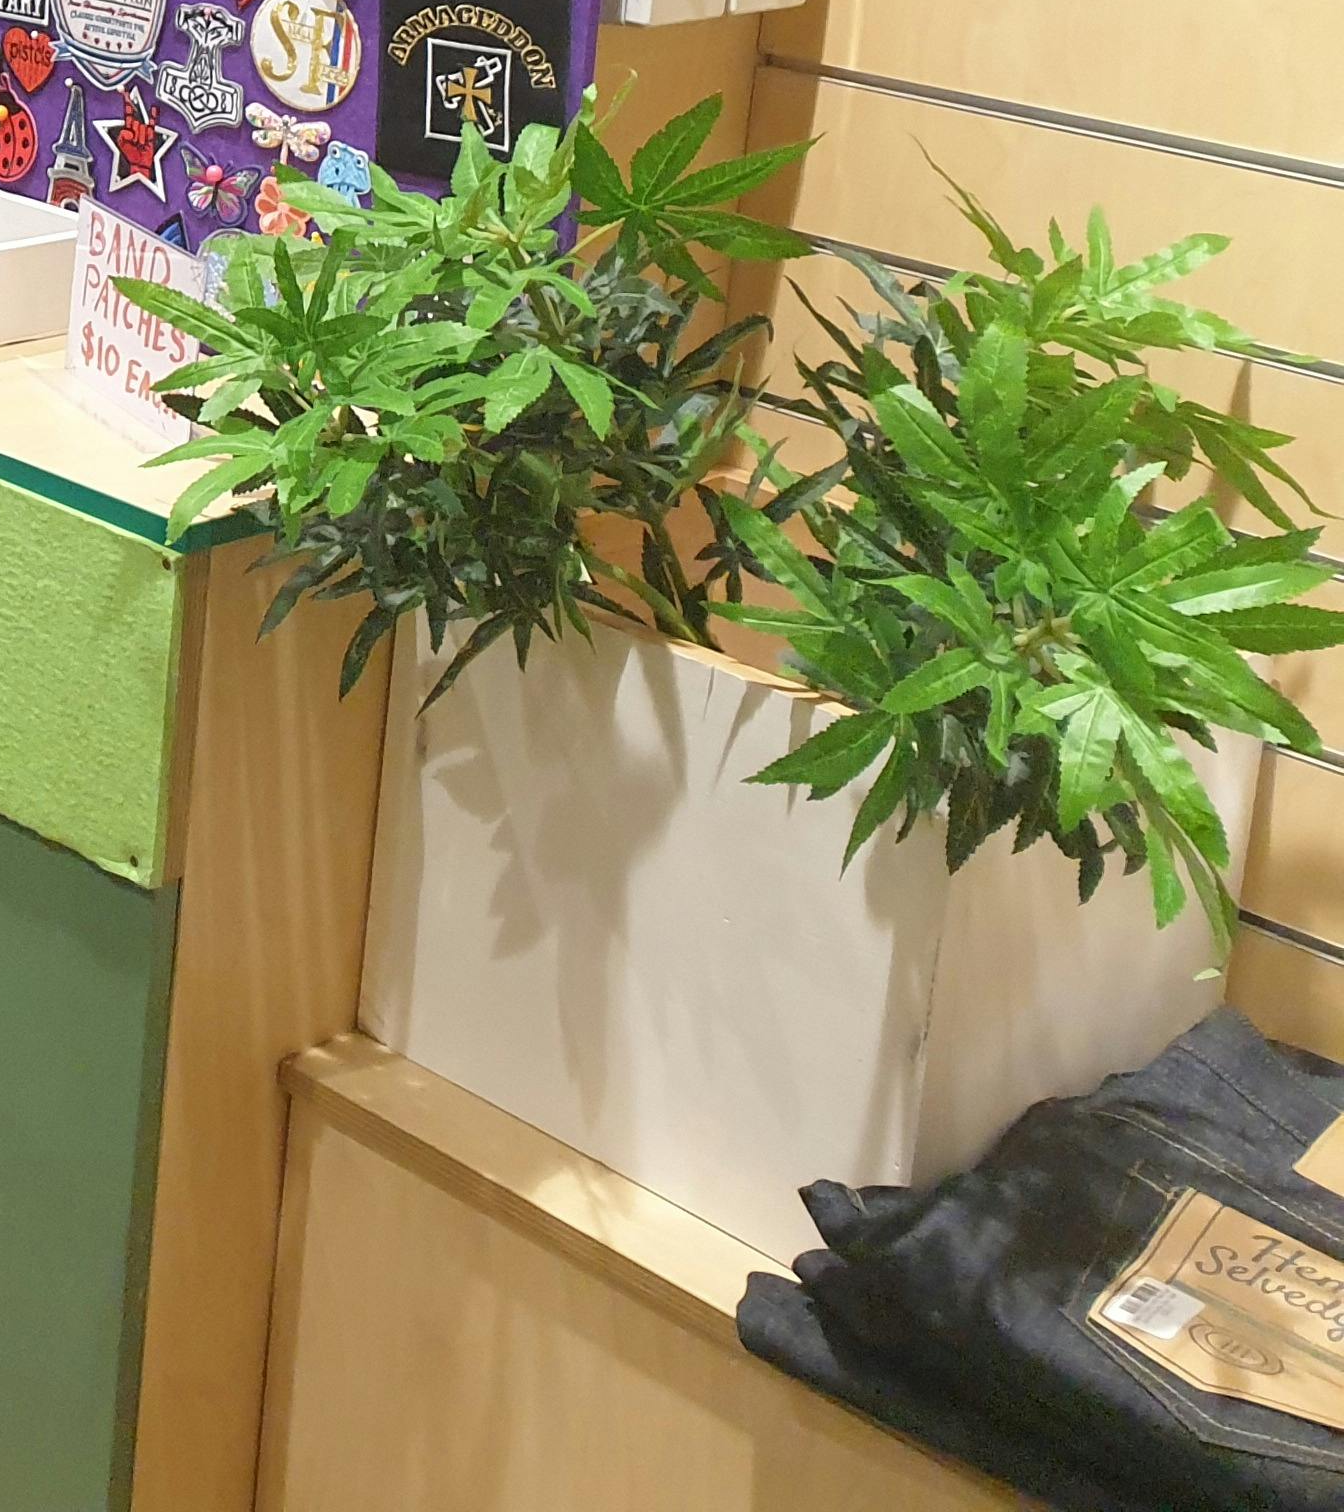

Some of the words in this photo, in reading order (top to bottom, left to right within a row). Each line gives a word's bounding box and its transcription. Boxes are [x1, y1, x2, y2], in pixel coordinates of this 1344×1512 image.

[387, 4, 557, 90] ARMAGEDDON
[88, 210, 172, 286] BAND
[81, 320, 121, 378] $10
